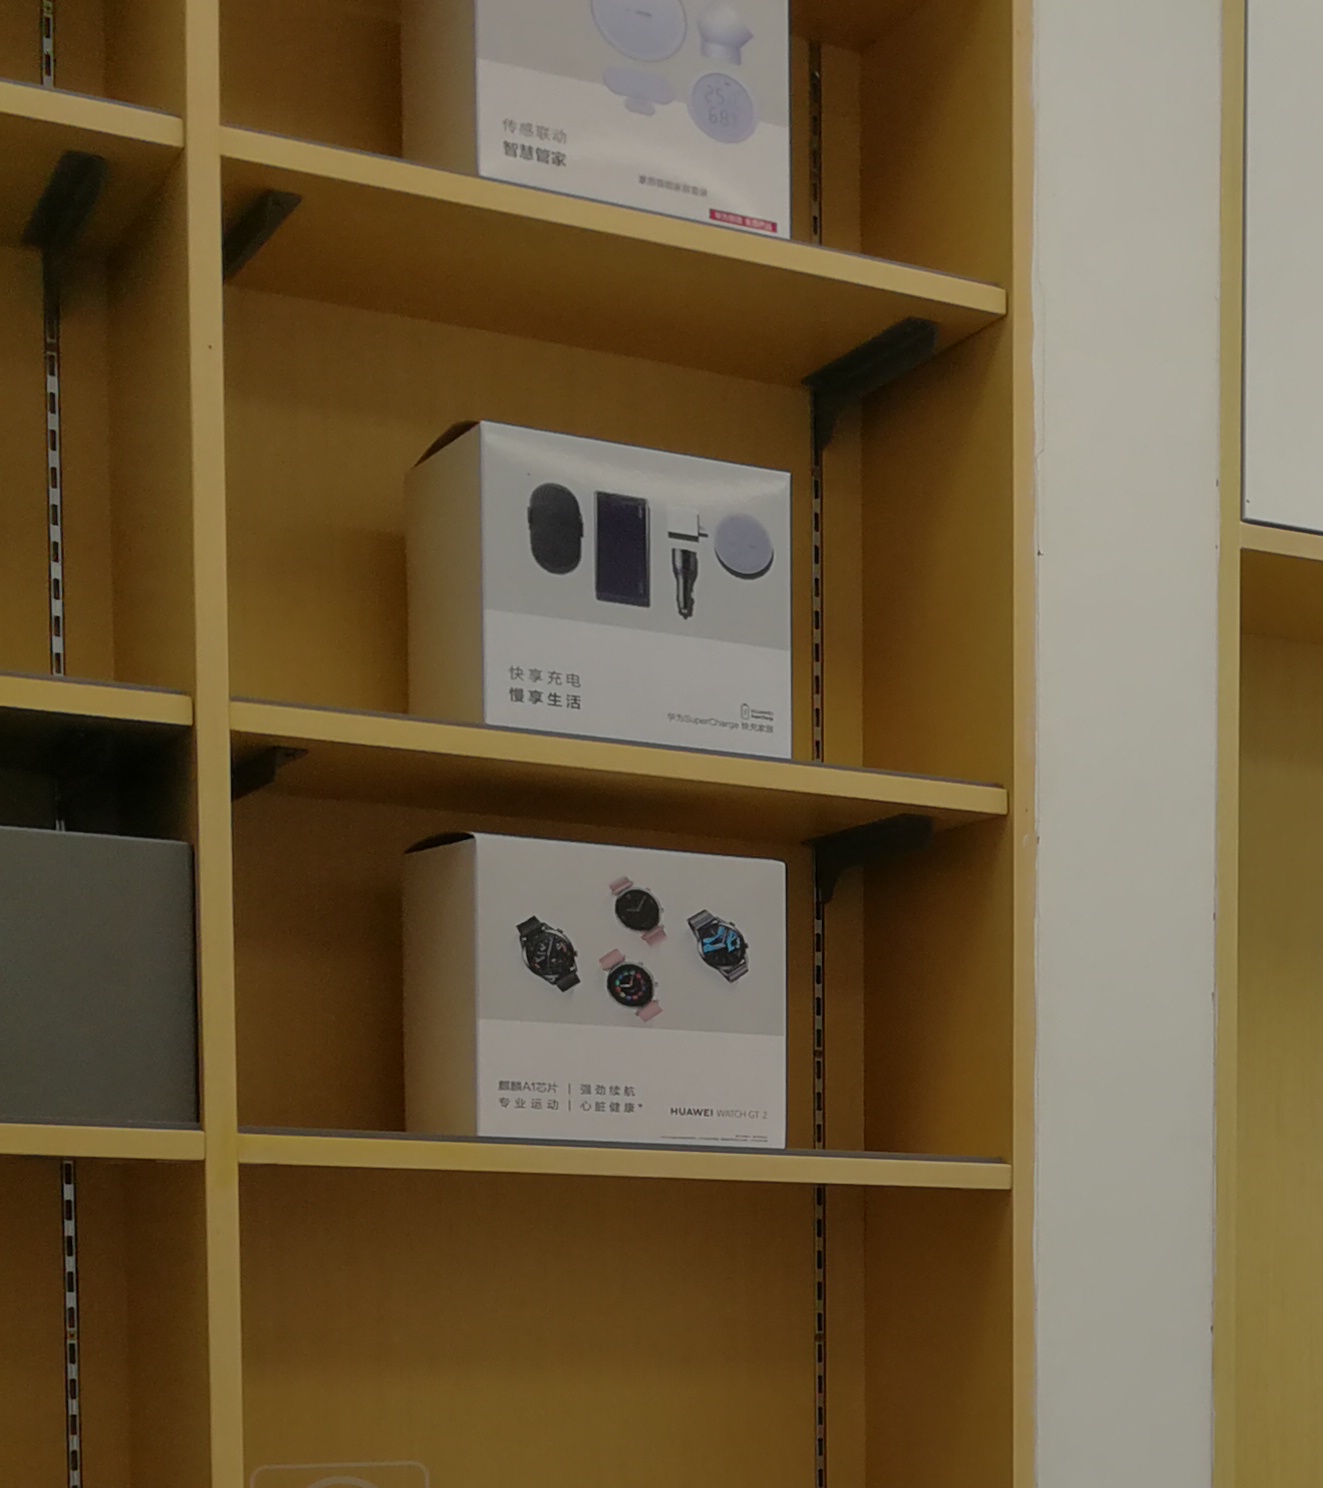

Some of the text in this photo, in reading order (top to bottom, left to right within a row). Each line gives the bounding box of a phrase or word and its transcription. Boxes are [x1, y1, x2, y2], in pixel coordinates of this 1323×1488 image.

[503, 117, 568, 145] 传感联动
[503, 141, 568, 168] 智慧管家
[508, 665, 582, 689] 快享充电
[508, 687, 582, 711] 慢享生活
[580, 1083, 637, 1098] 强劲续航
[498, 1097, 560, 1112] 专业运动
[669, 1106, 768, 1120] HUAWEI WATCH GT 2
